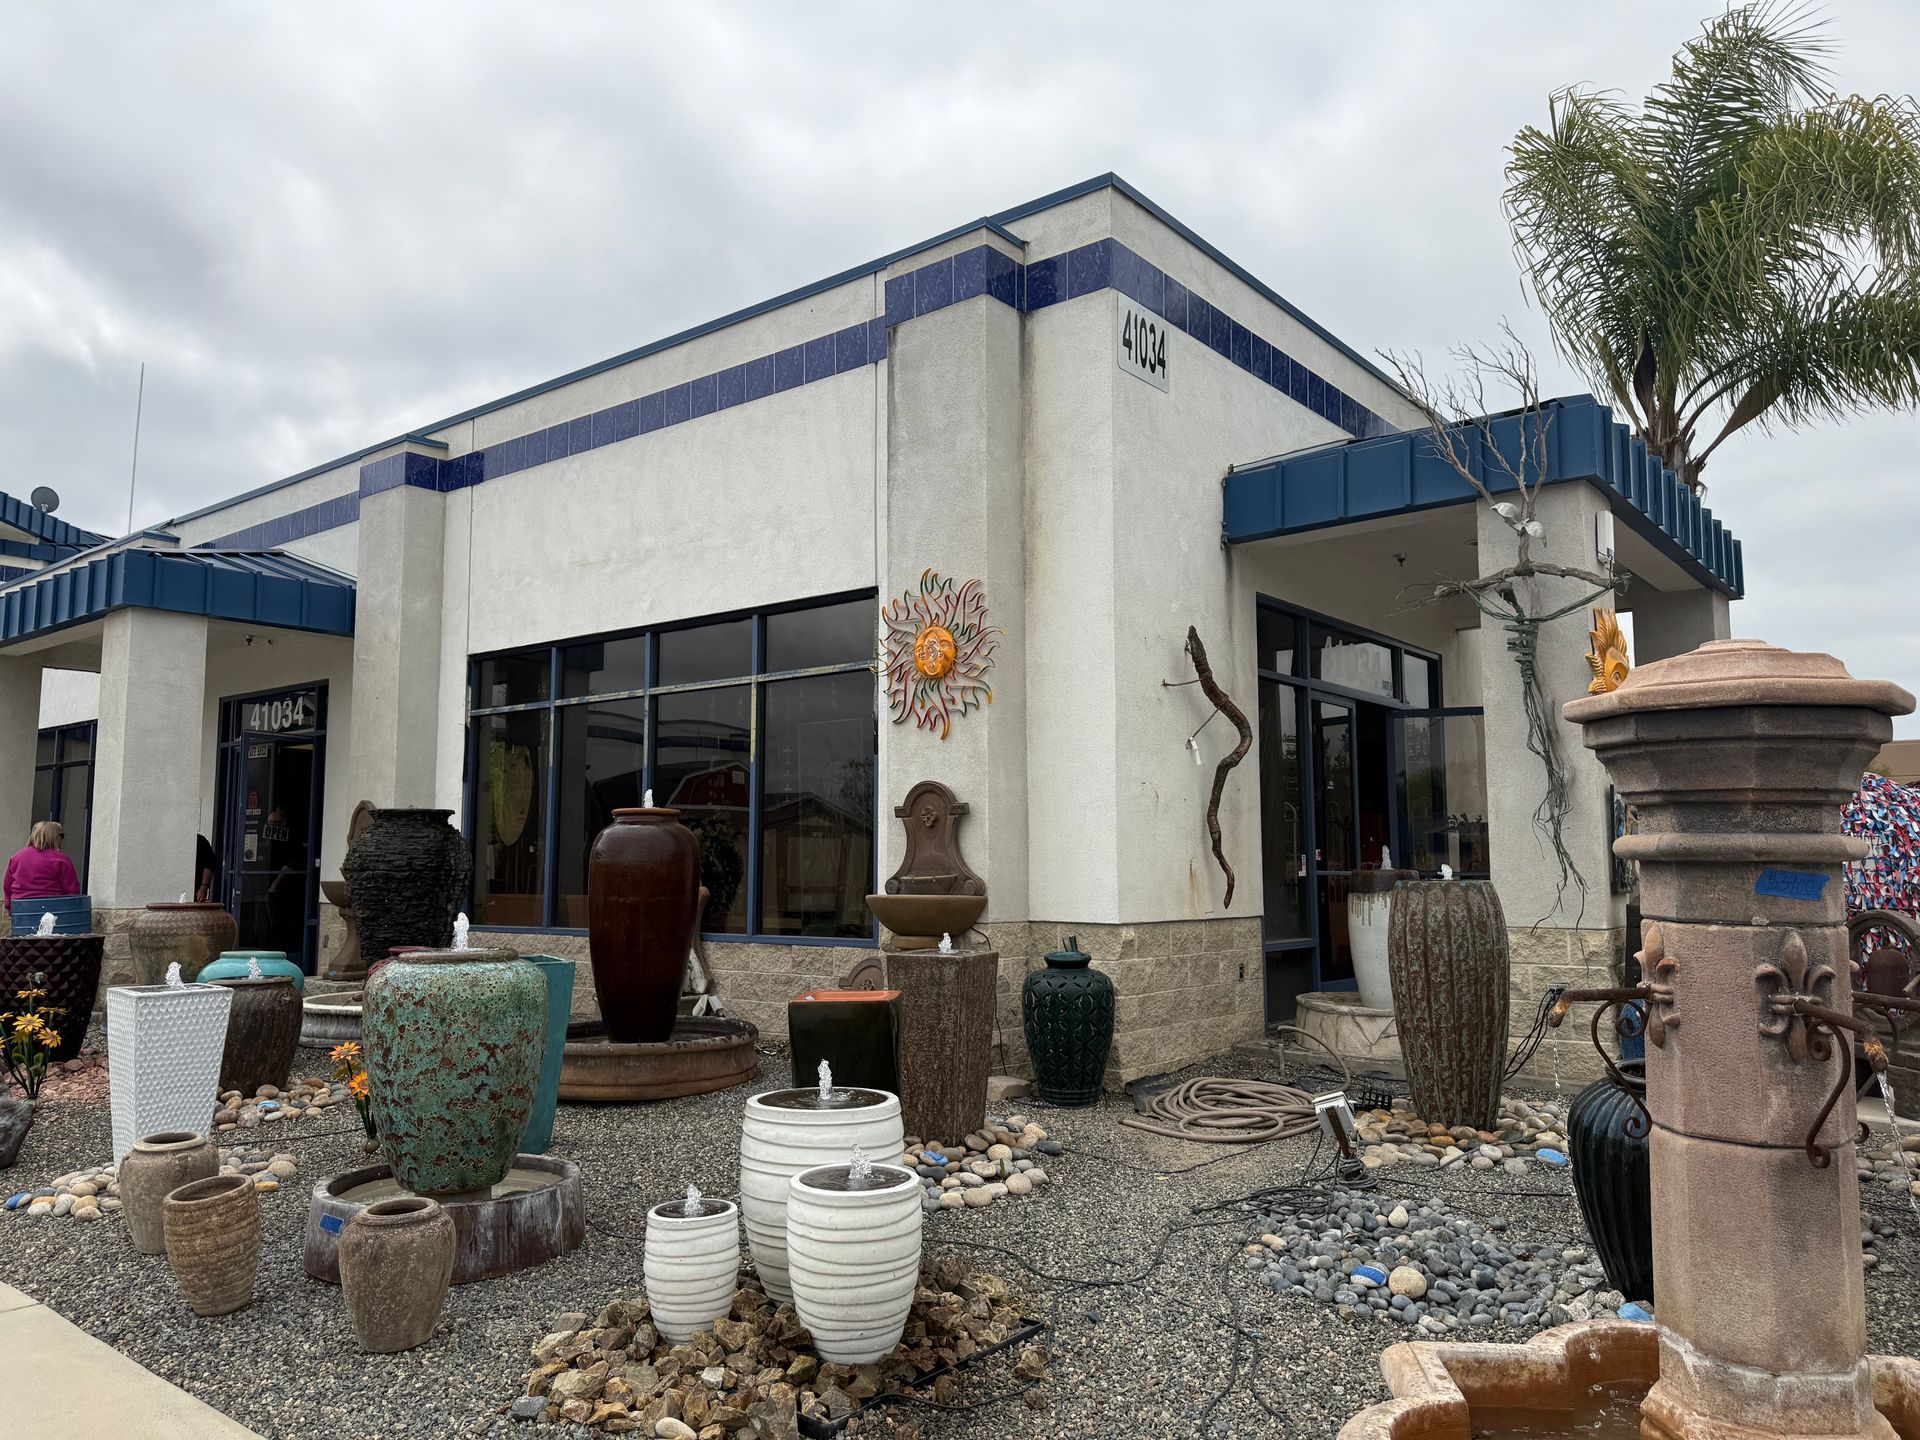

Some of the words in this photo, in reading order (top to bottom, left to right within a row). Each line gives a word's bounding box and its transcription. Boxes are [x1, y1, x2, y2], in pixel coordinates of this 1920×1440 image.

[1122, 309, 1166, 379] 41034
[250, 696, 304, 730] 41034
[265, 825, 288, 841] OPEN
